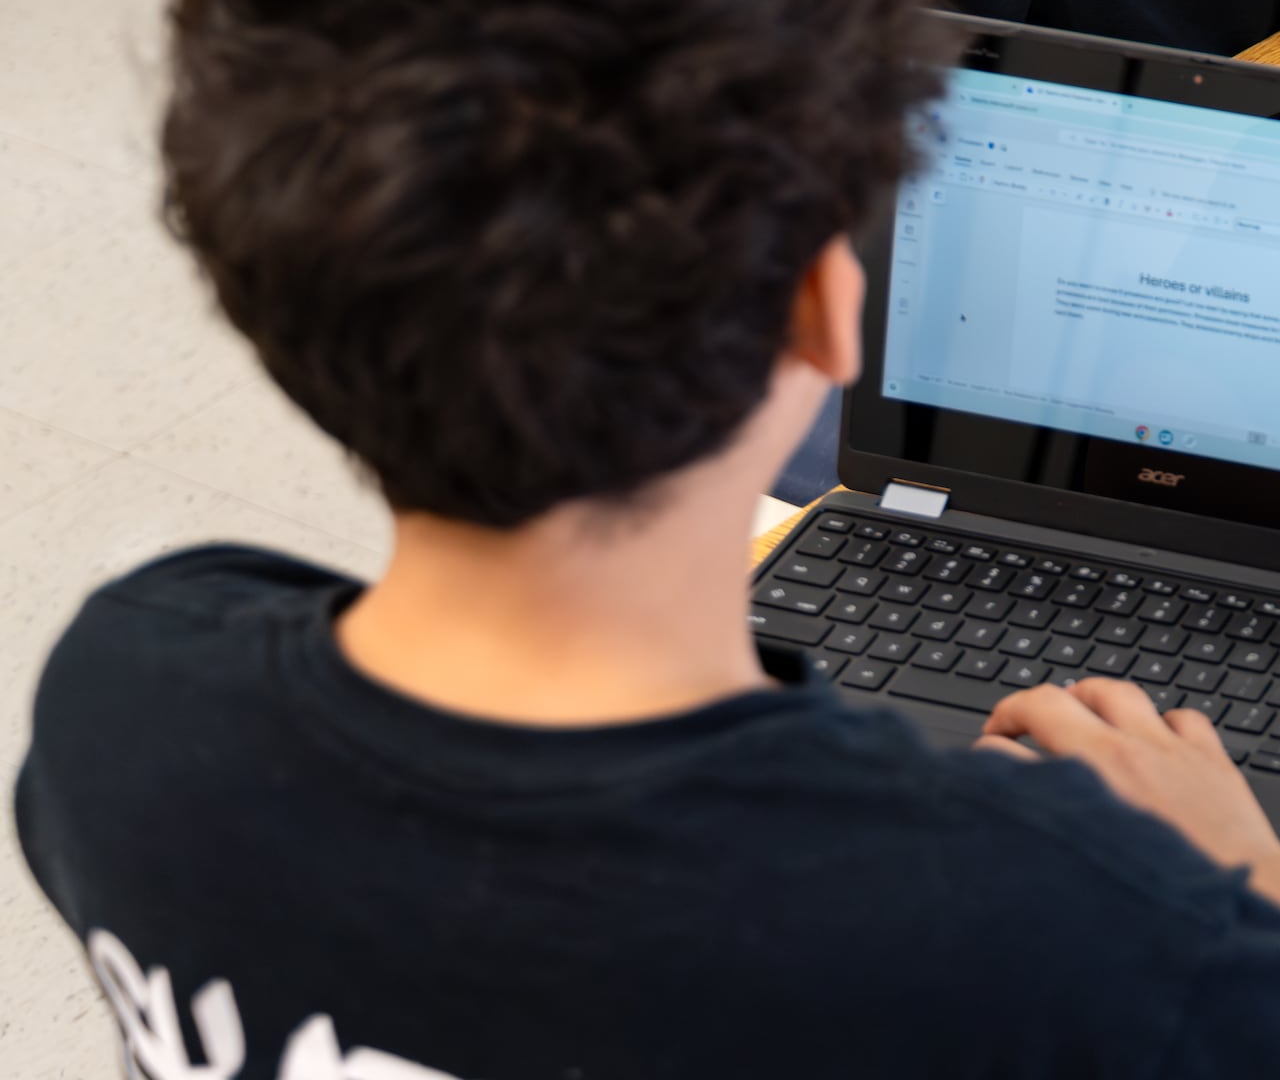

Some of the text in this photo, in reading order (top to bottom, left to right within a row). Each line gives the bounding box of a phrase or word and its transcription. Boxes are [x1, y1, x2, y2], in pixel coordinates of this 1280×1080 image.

[1139, 272, 1251, 304] Heroes or villains
[1136, 467, 1186, 488] acer
